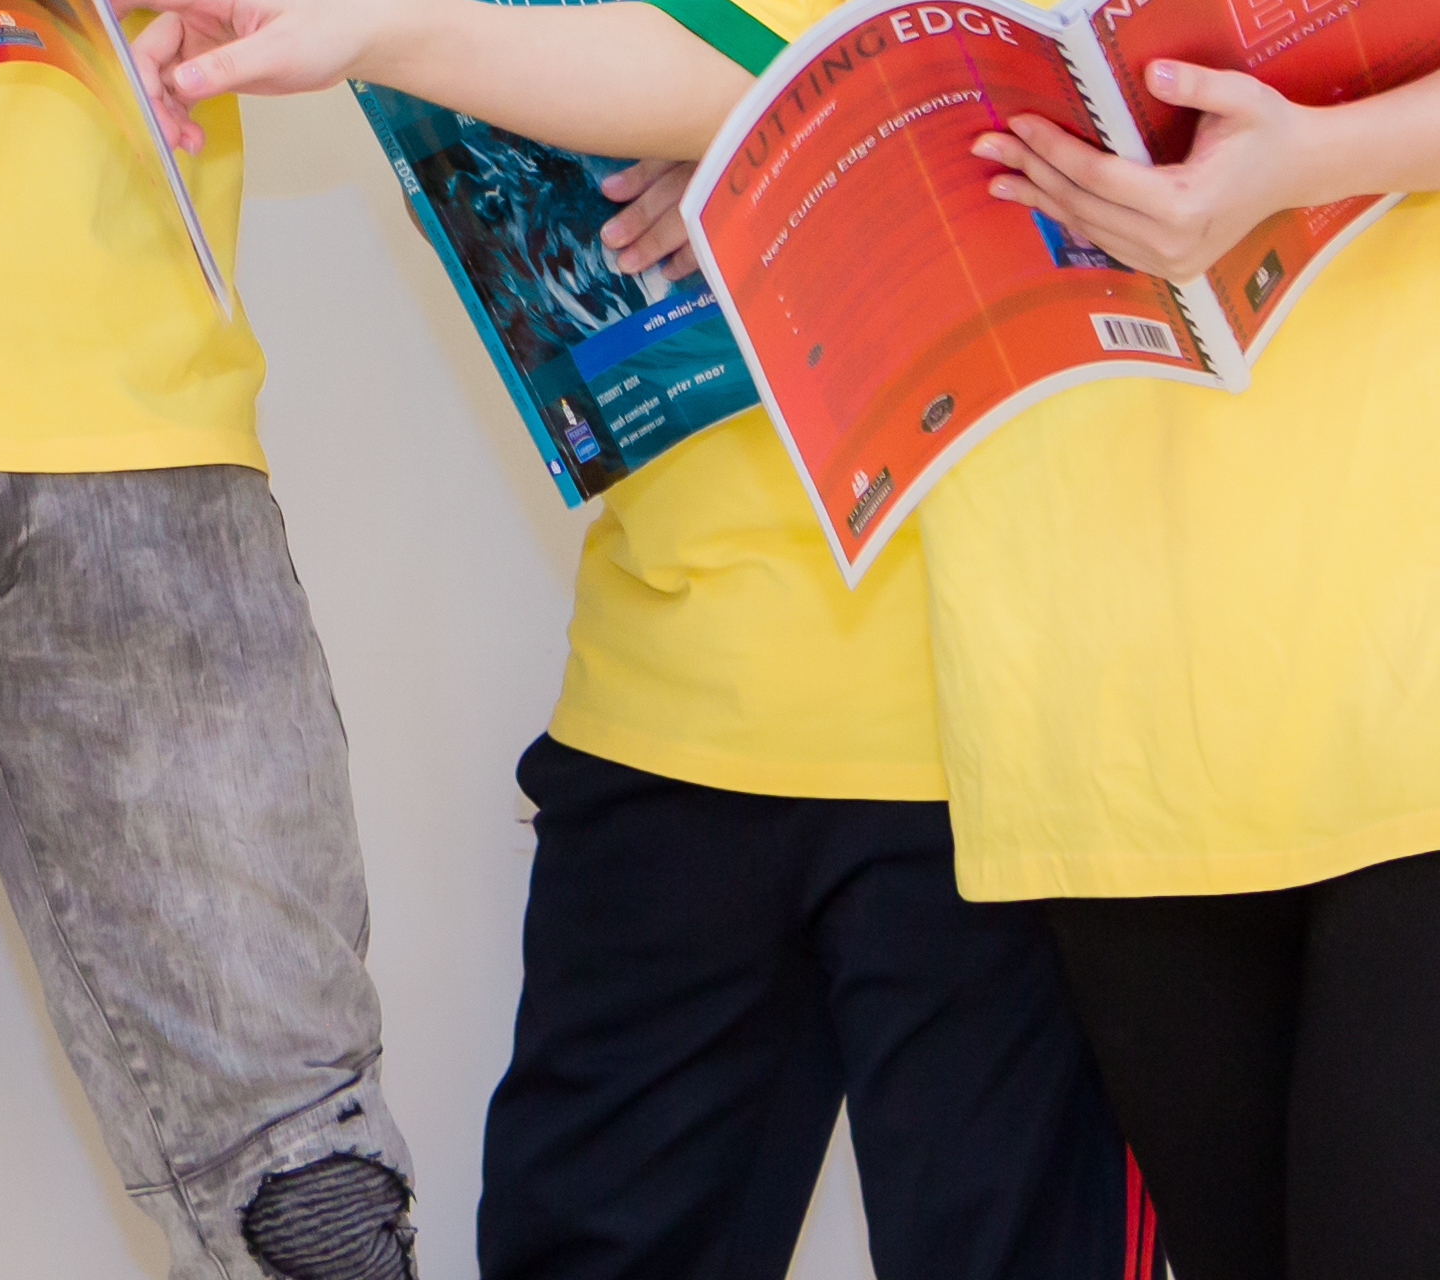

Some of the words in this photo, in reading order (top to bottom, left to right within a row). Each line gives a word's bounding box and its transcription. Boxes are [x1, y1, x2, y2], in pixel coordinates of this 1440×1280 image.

[728, 26, 887, 197] CUTTING
[890, 6, 1019, 47] EDGE
[791, 98, 838, 154] sharper
[362, 97, 401, 159] CUTTING
[392, 156, 421, 197] EDGE
[761, 228, 789, 268] New
[788, 170, 837, 230] Cutting
[836, 135, 878, 174] Edge
[877, 88, 984, 140] Elementary
[643, 316, 666, 332] with
[666, 378, 692, 402] peter
[693, 363, 725, 385] moor
